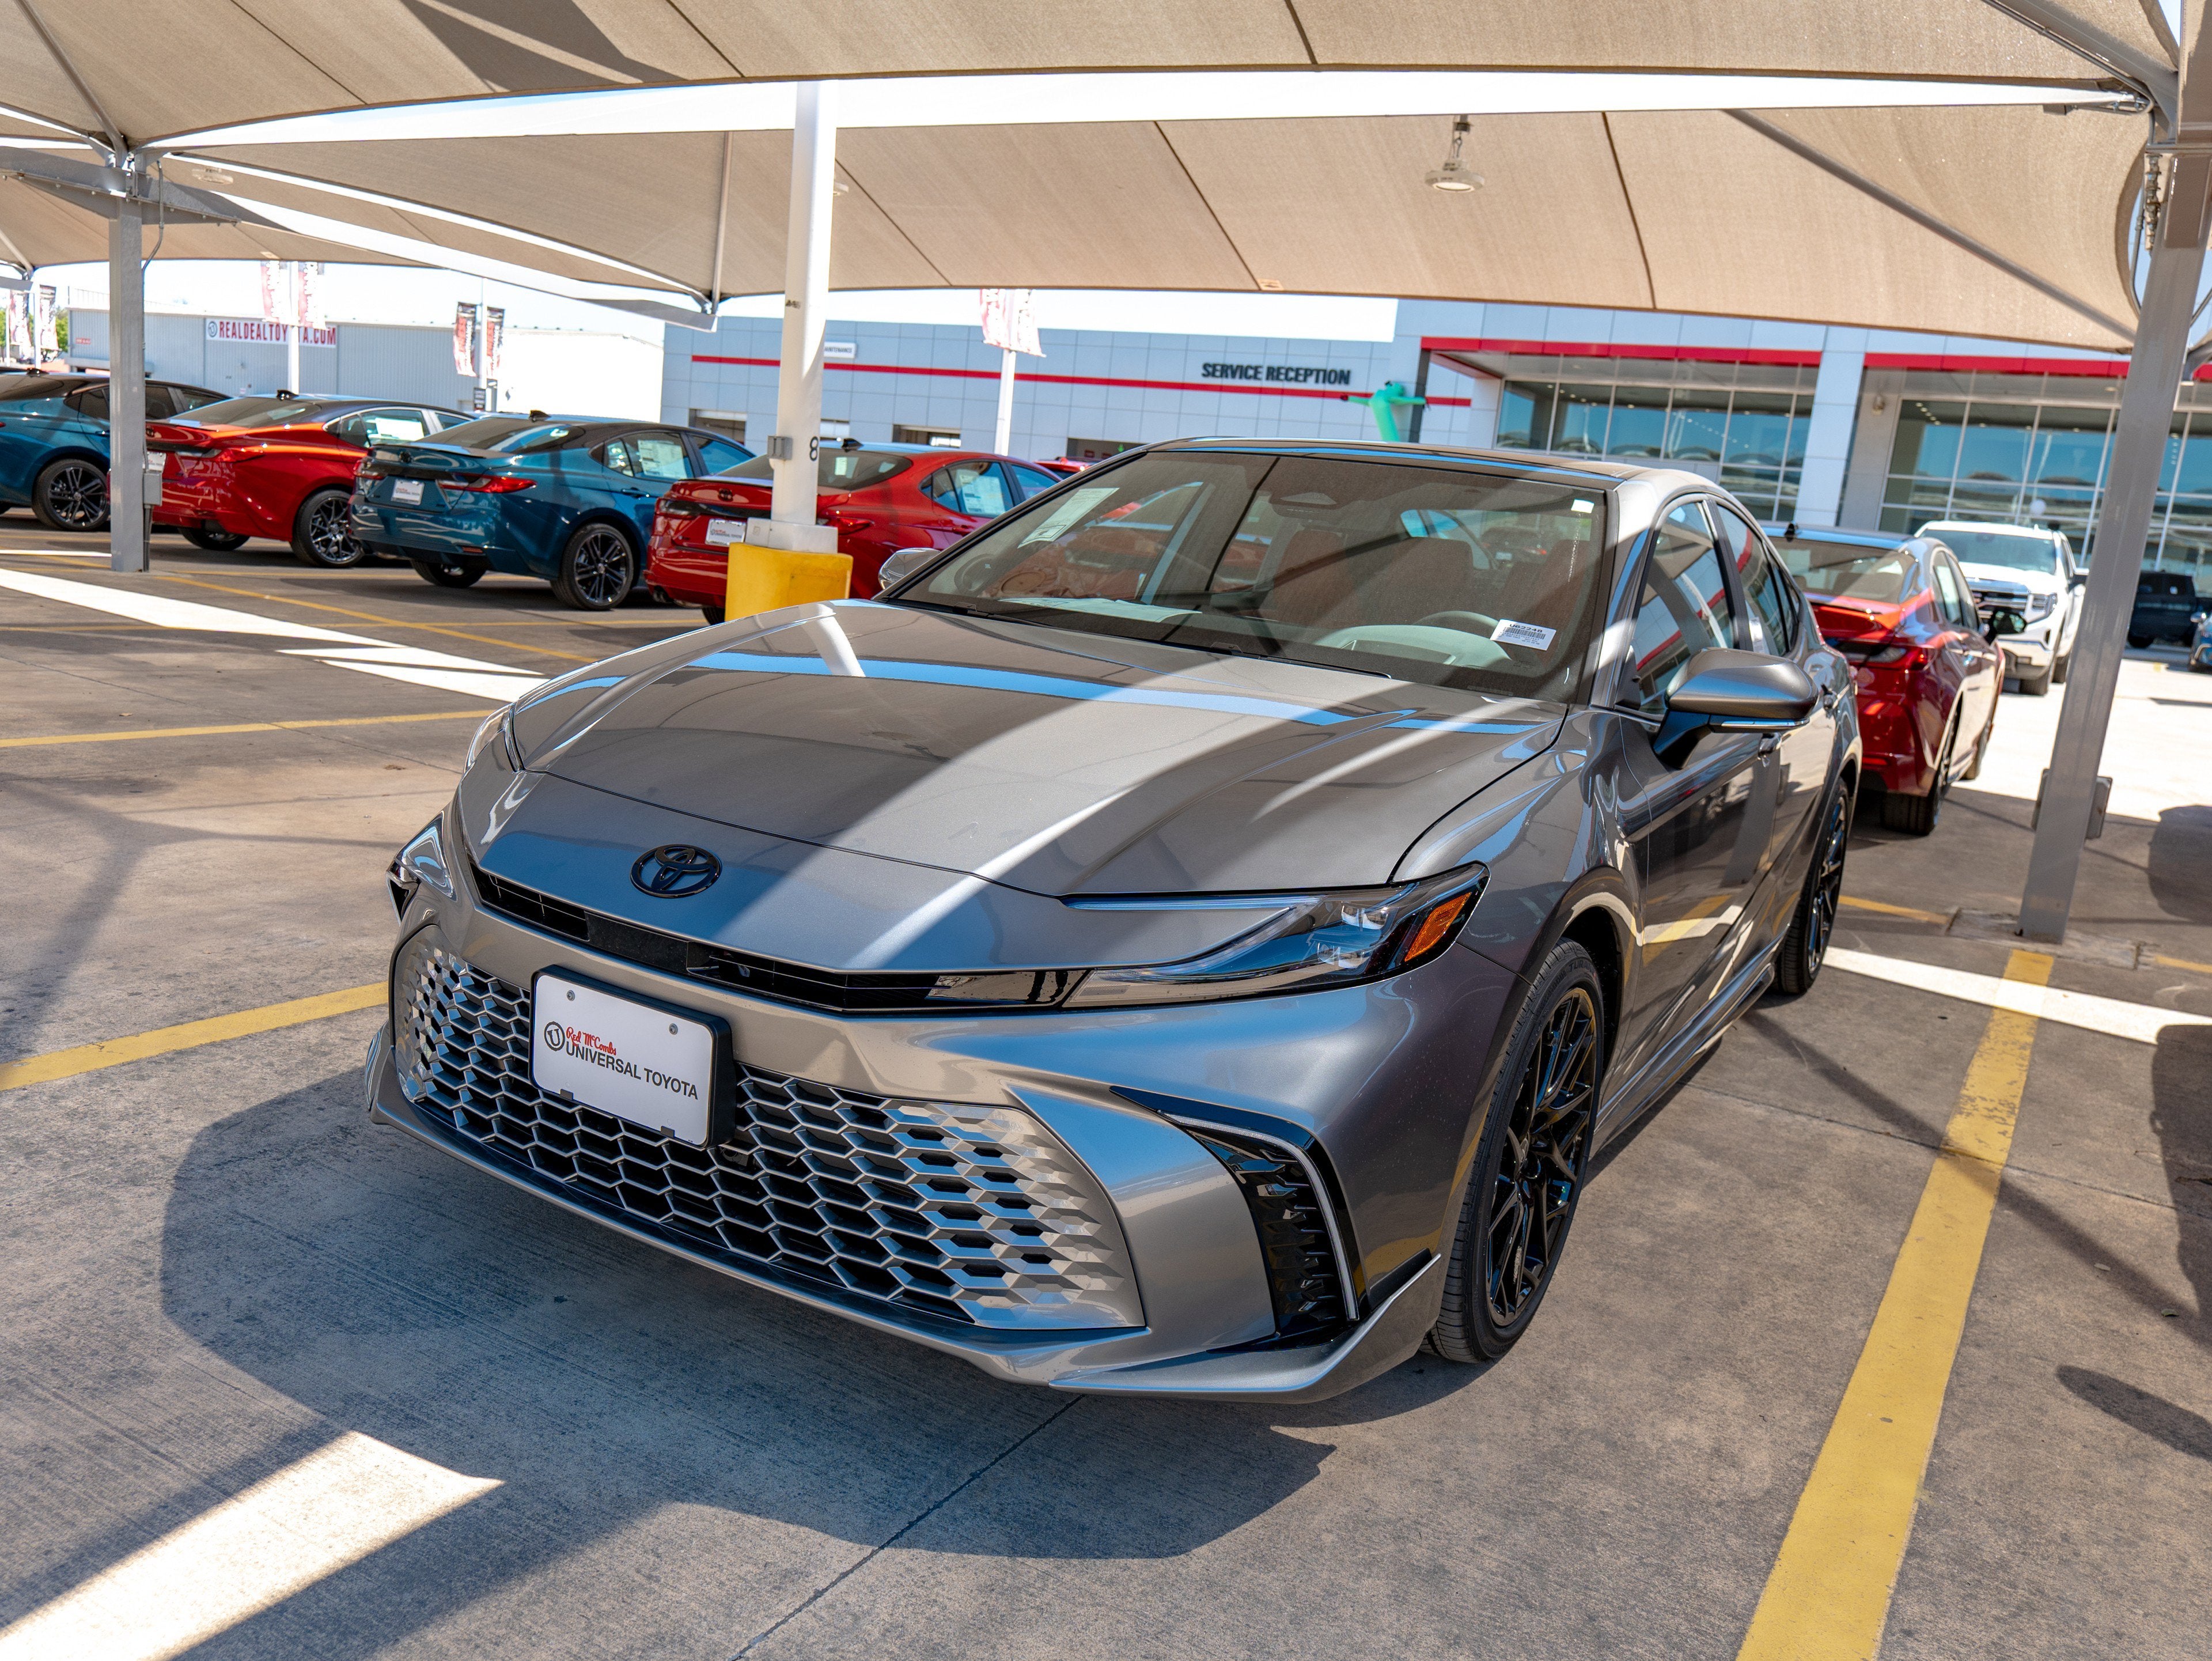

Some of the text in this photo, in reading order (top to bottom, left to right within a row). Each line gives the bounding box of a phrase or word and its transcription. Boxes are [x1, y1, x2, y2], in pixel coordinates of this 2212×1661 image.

[219, 321, 336, 345] REALDEALTOYA.COM
[1201, 363, 1351, 385] SERVICE RECEPTION
[809, 436, 819, 461] 8
[566, 1027, 617, 1055] Red McCombs
[566, 1041, 698, 1100] UNIVERSAL TOYOTA
